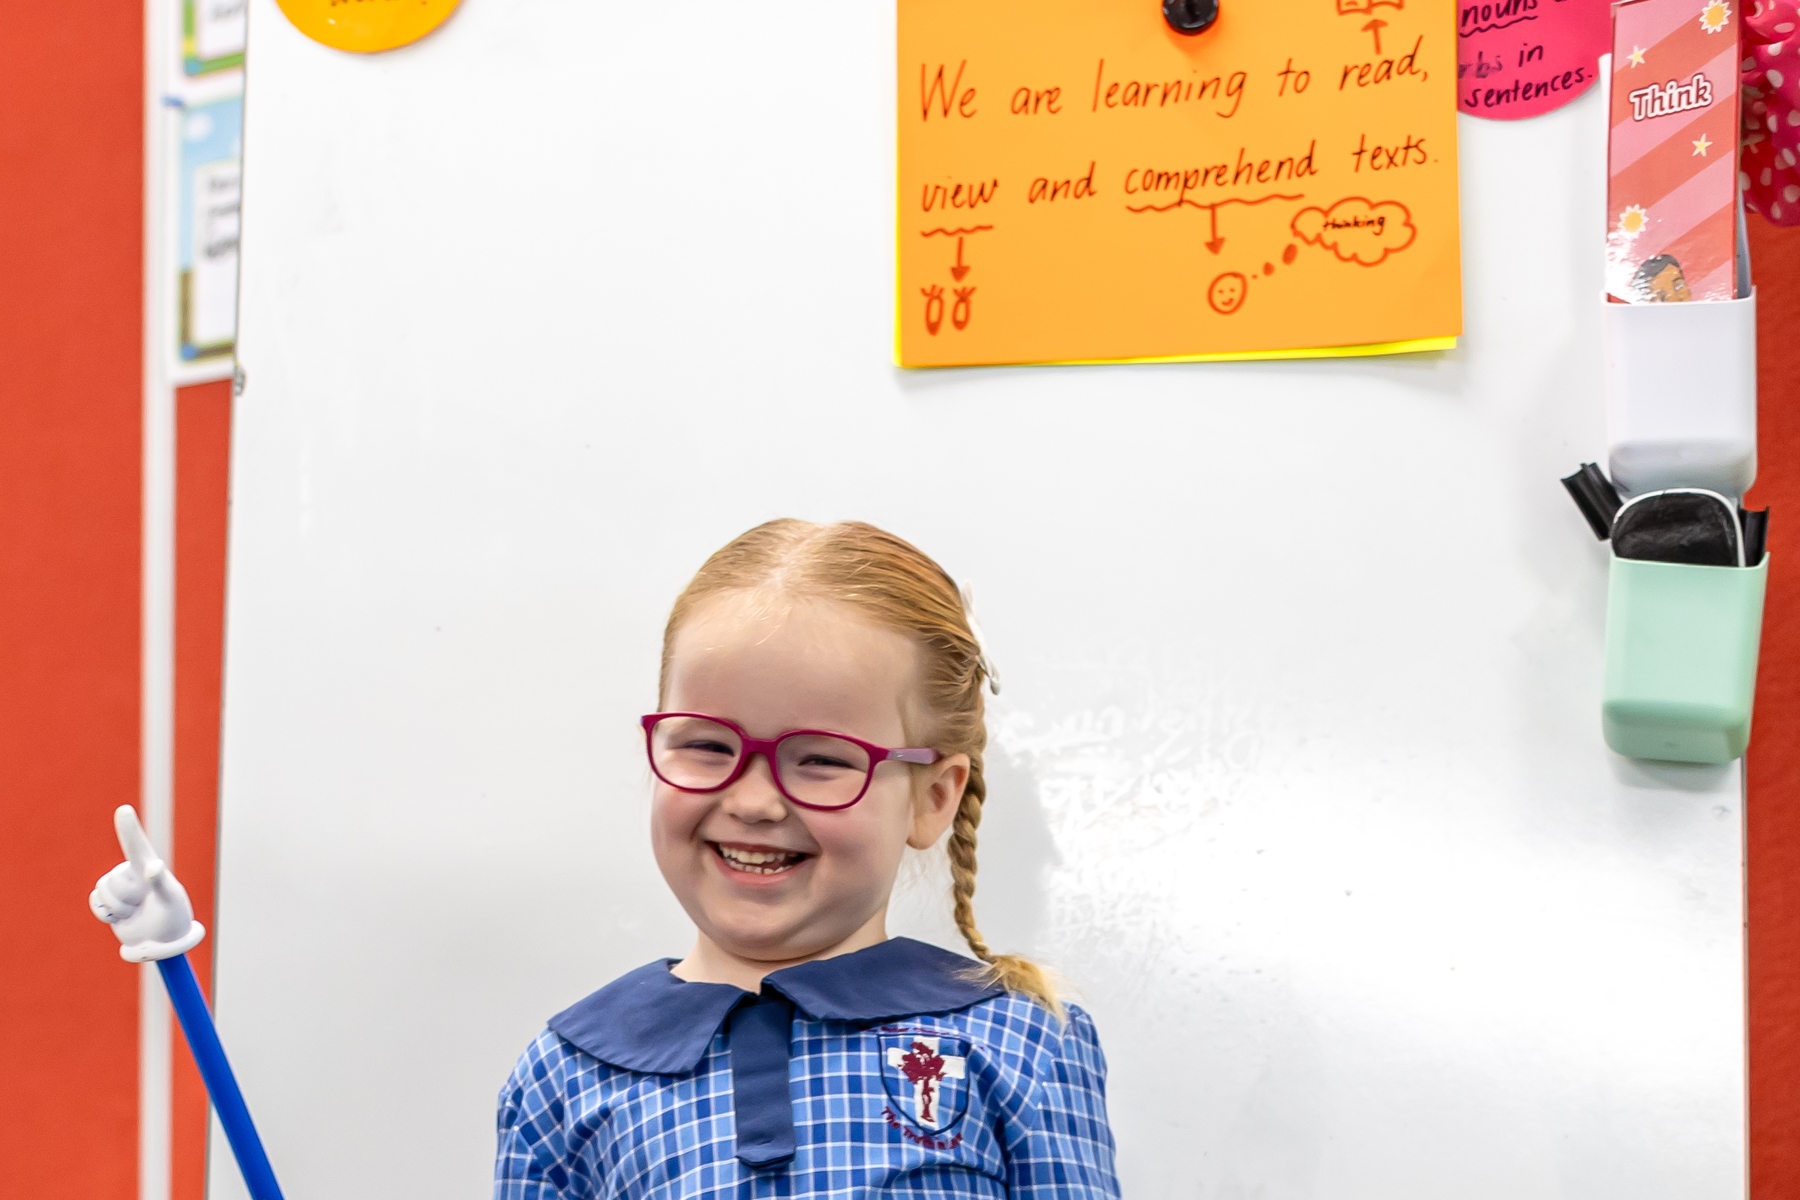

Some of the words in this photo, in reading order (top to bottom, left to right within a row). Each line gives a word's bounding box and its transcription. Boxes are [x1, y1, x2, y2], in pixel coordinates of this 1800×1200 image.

[920, 59, 978, 122] We
[1010, 86, 1063, 115] are
[1091, 57, 1247, 119] learning
[1276, 57, 1311, 97] to
[1338, 34, 1429, 91] read,
[1457, 51, 1504, 79] rbs
[1518, 43, 1544, 68] in
[1464, 67, 1593, 108] sentences.
[1628, 73, 1713, 122] Think
[921, 176, 998, 212] view
[1027, 160, 1098, 204] and
[1124, 139, 1319, 207] comprehend
[1351, 133, 1439, 173] texts.
